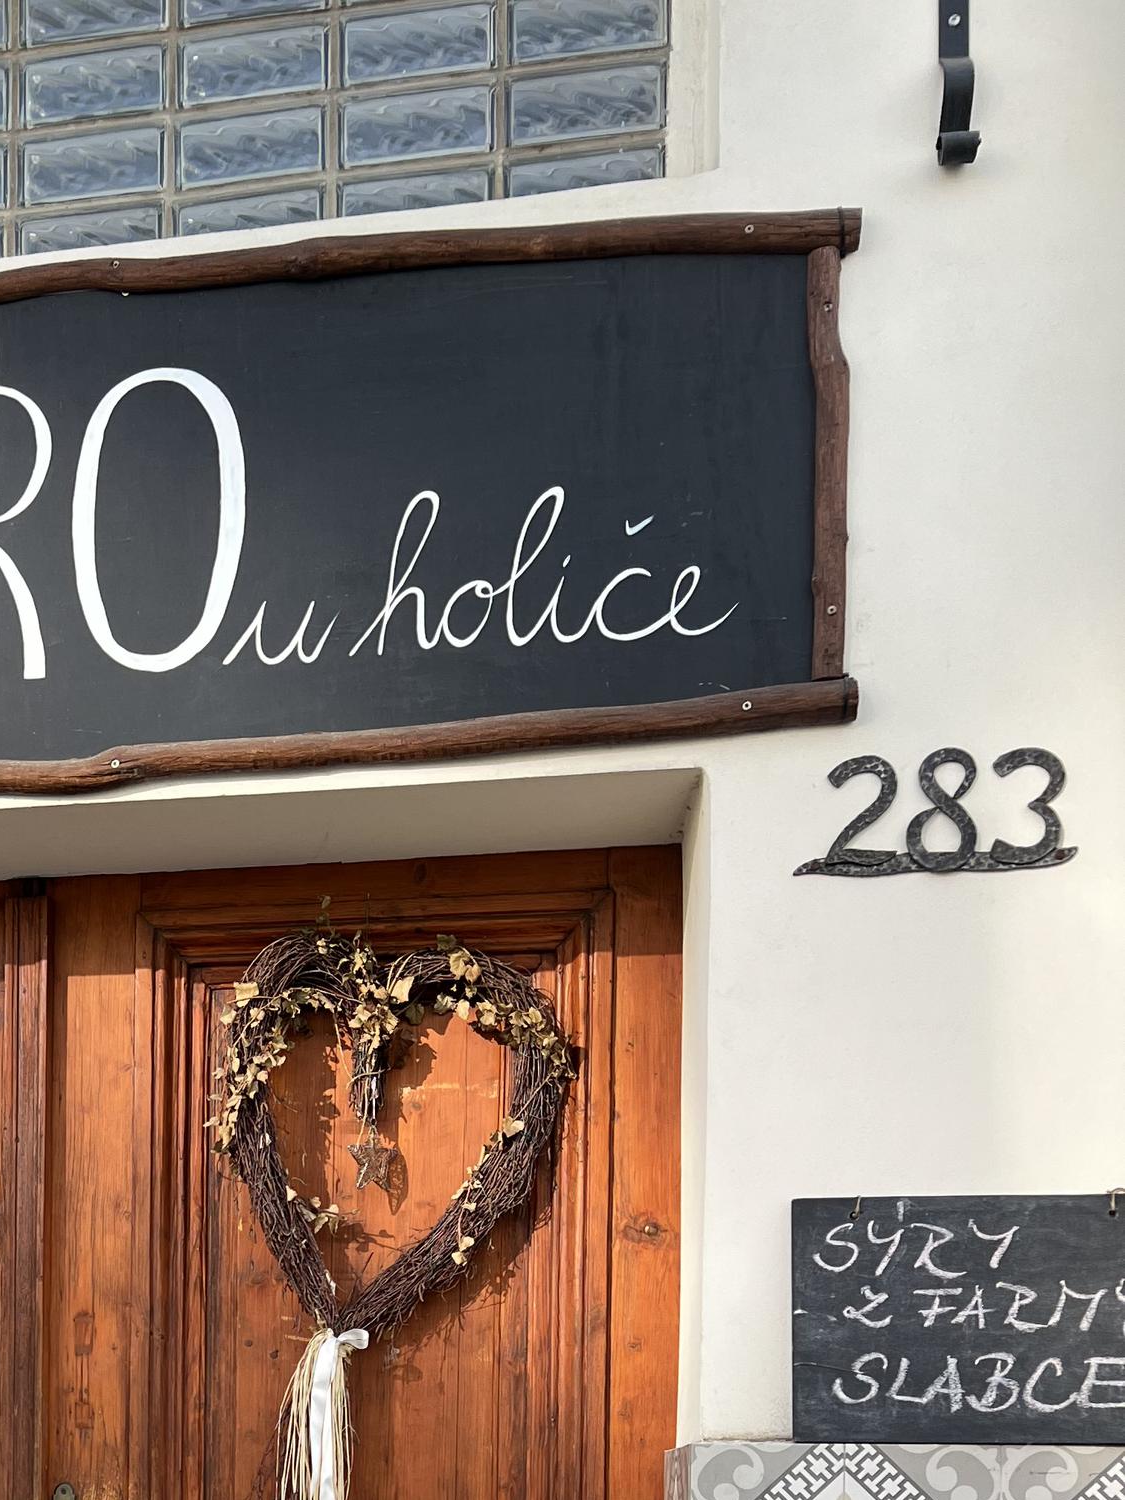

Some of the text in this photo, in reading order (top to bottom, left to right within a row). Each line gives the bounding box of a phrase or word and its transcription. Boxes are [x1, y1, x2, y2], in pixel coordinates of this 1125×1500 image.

[221, 599, 341, 667] u
[349, 485, 741, 657] holiče
[827, 746, 1067, 872] 283
[831, 1351, 1125, 1414] SLABCE
